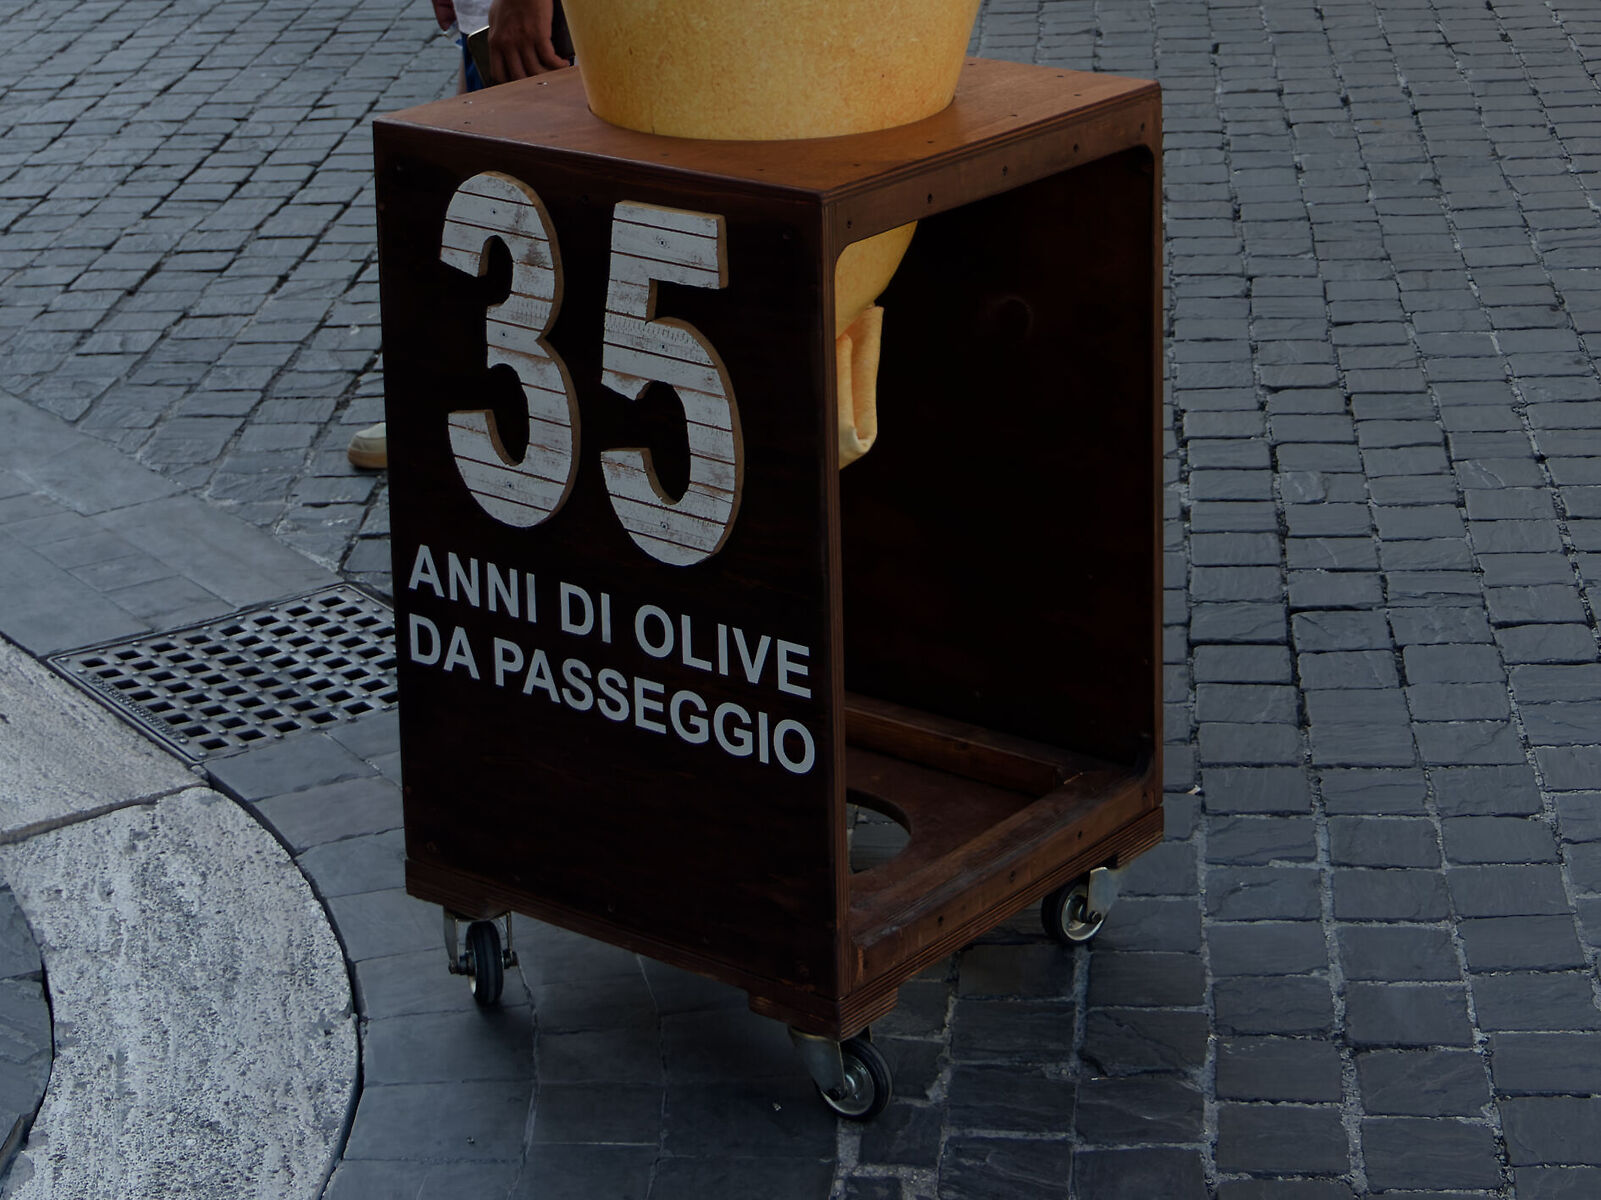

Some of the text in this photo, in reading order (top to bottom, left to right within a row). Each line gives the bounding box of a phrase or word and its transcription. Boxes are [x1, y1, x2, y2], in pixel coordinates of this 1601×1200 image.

[439, 170, 745, 566] 35
[408, 544, 813, 699] ANNI DI OLIVE
[409, 613, 816, 774] DA PASSEGGIO
